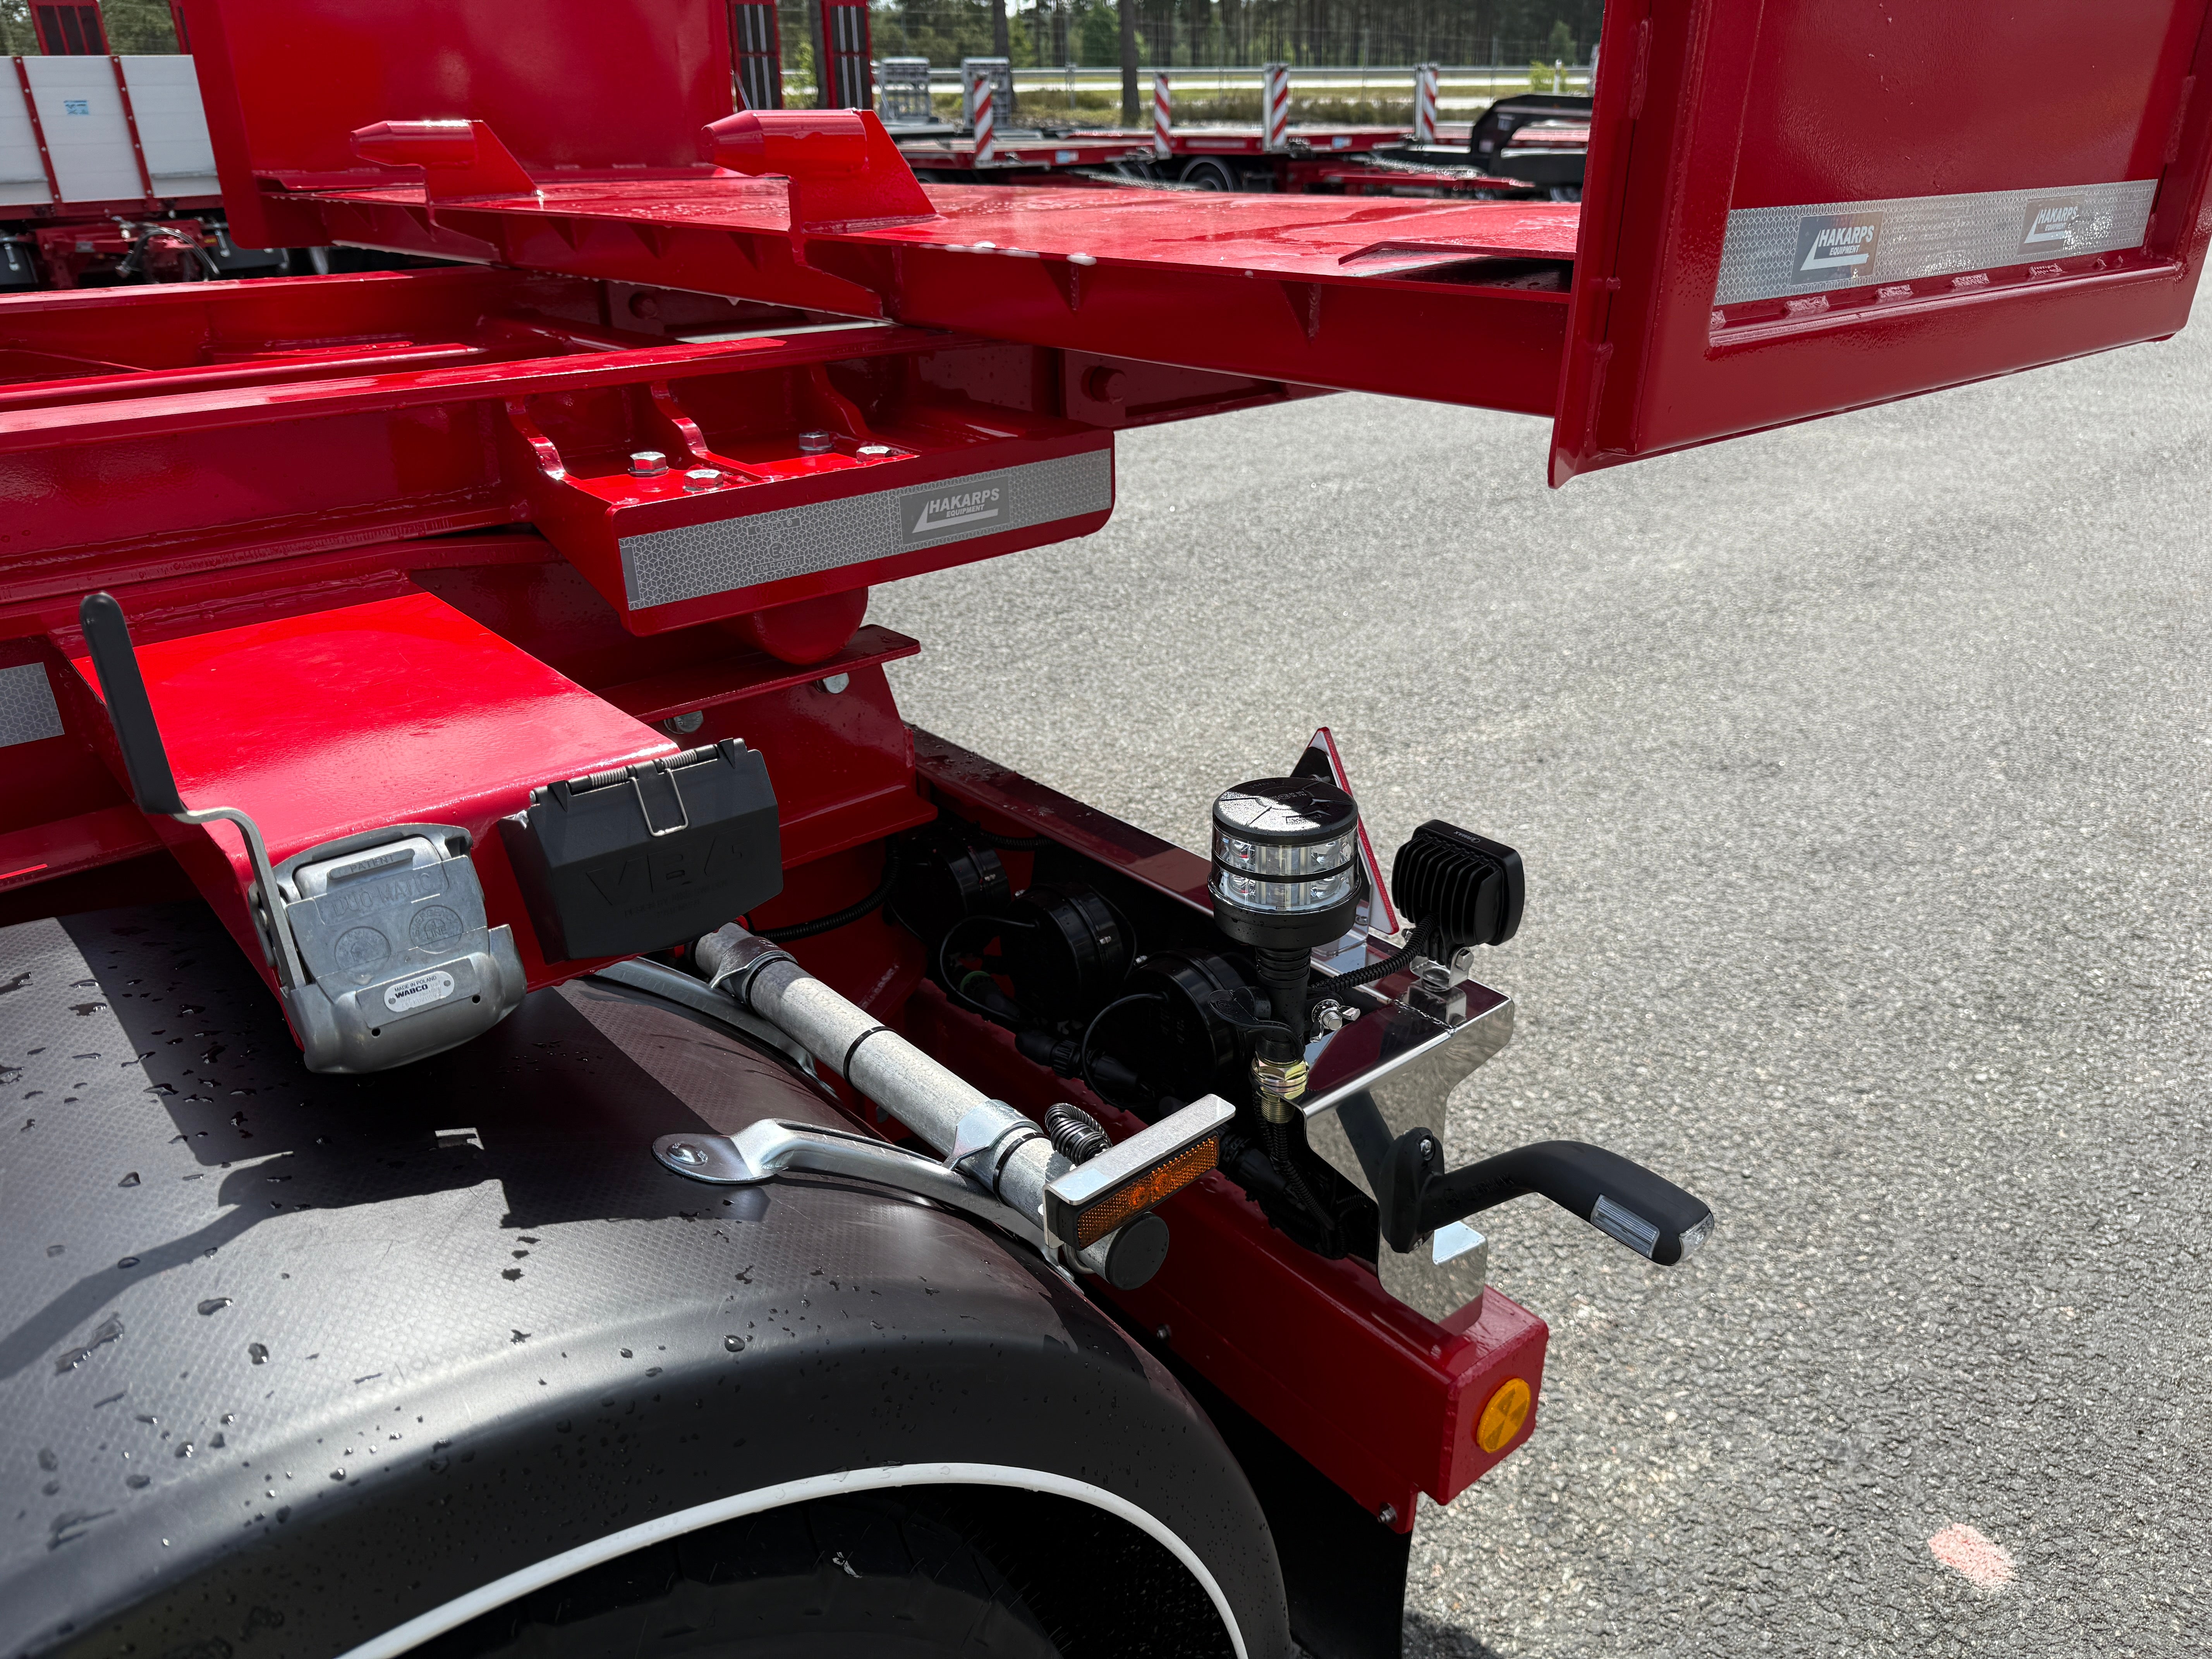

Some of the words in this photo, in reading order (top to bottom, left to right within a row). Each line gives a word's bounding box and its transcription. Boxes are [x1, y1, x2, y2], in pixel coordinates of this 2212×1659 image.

[2038, 206, 2078, 224] HAKARPS
[1818, 225, 1874, 247] HAKARPS
[1829, 245, 1860, 256] EQUIPMENT
[929, 488, 1000, 514] HAKARPS
[946, 504, 985, 518] EQUIPMENT
[770, 558, 801, 570] R-000001
[350, 853, 393, 872] PATENT
[331, 873, 433, 917] DUO-MATIC
[426, 927, 448, 940] LINE
[416, 975, 437, 985] POLAND
[395, 984, 428, 998] WABCO
